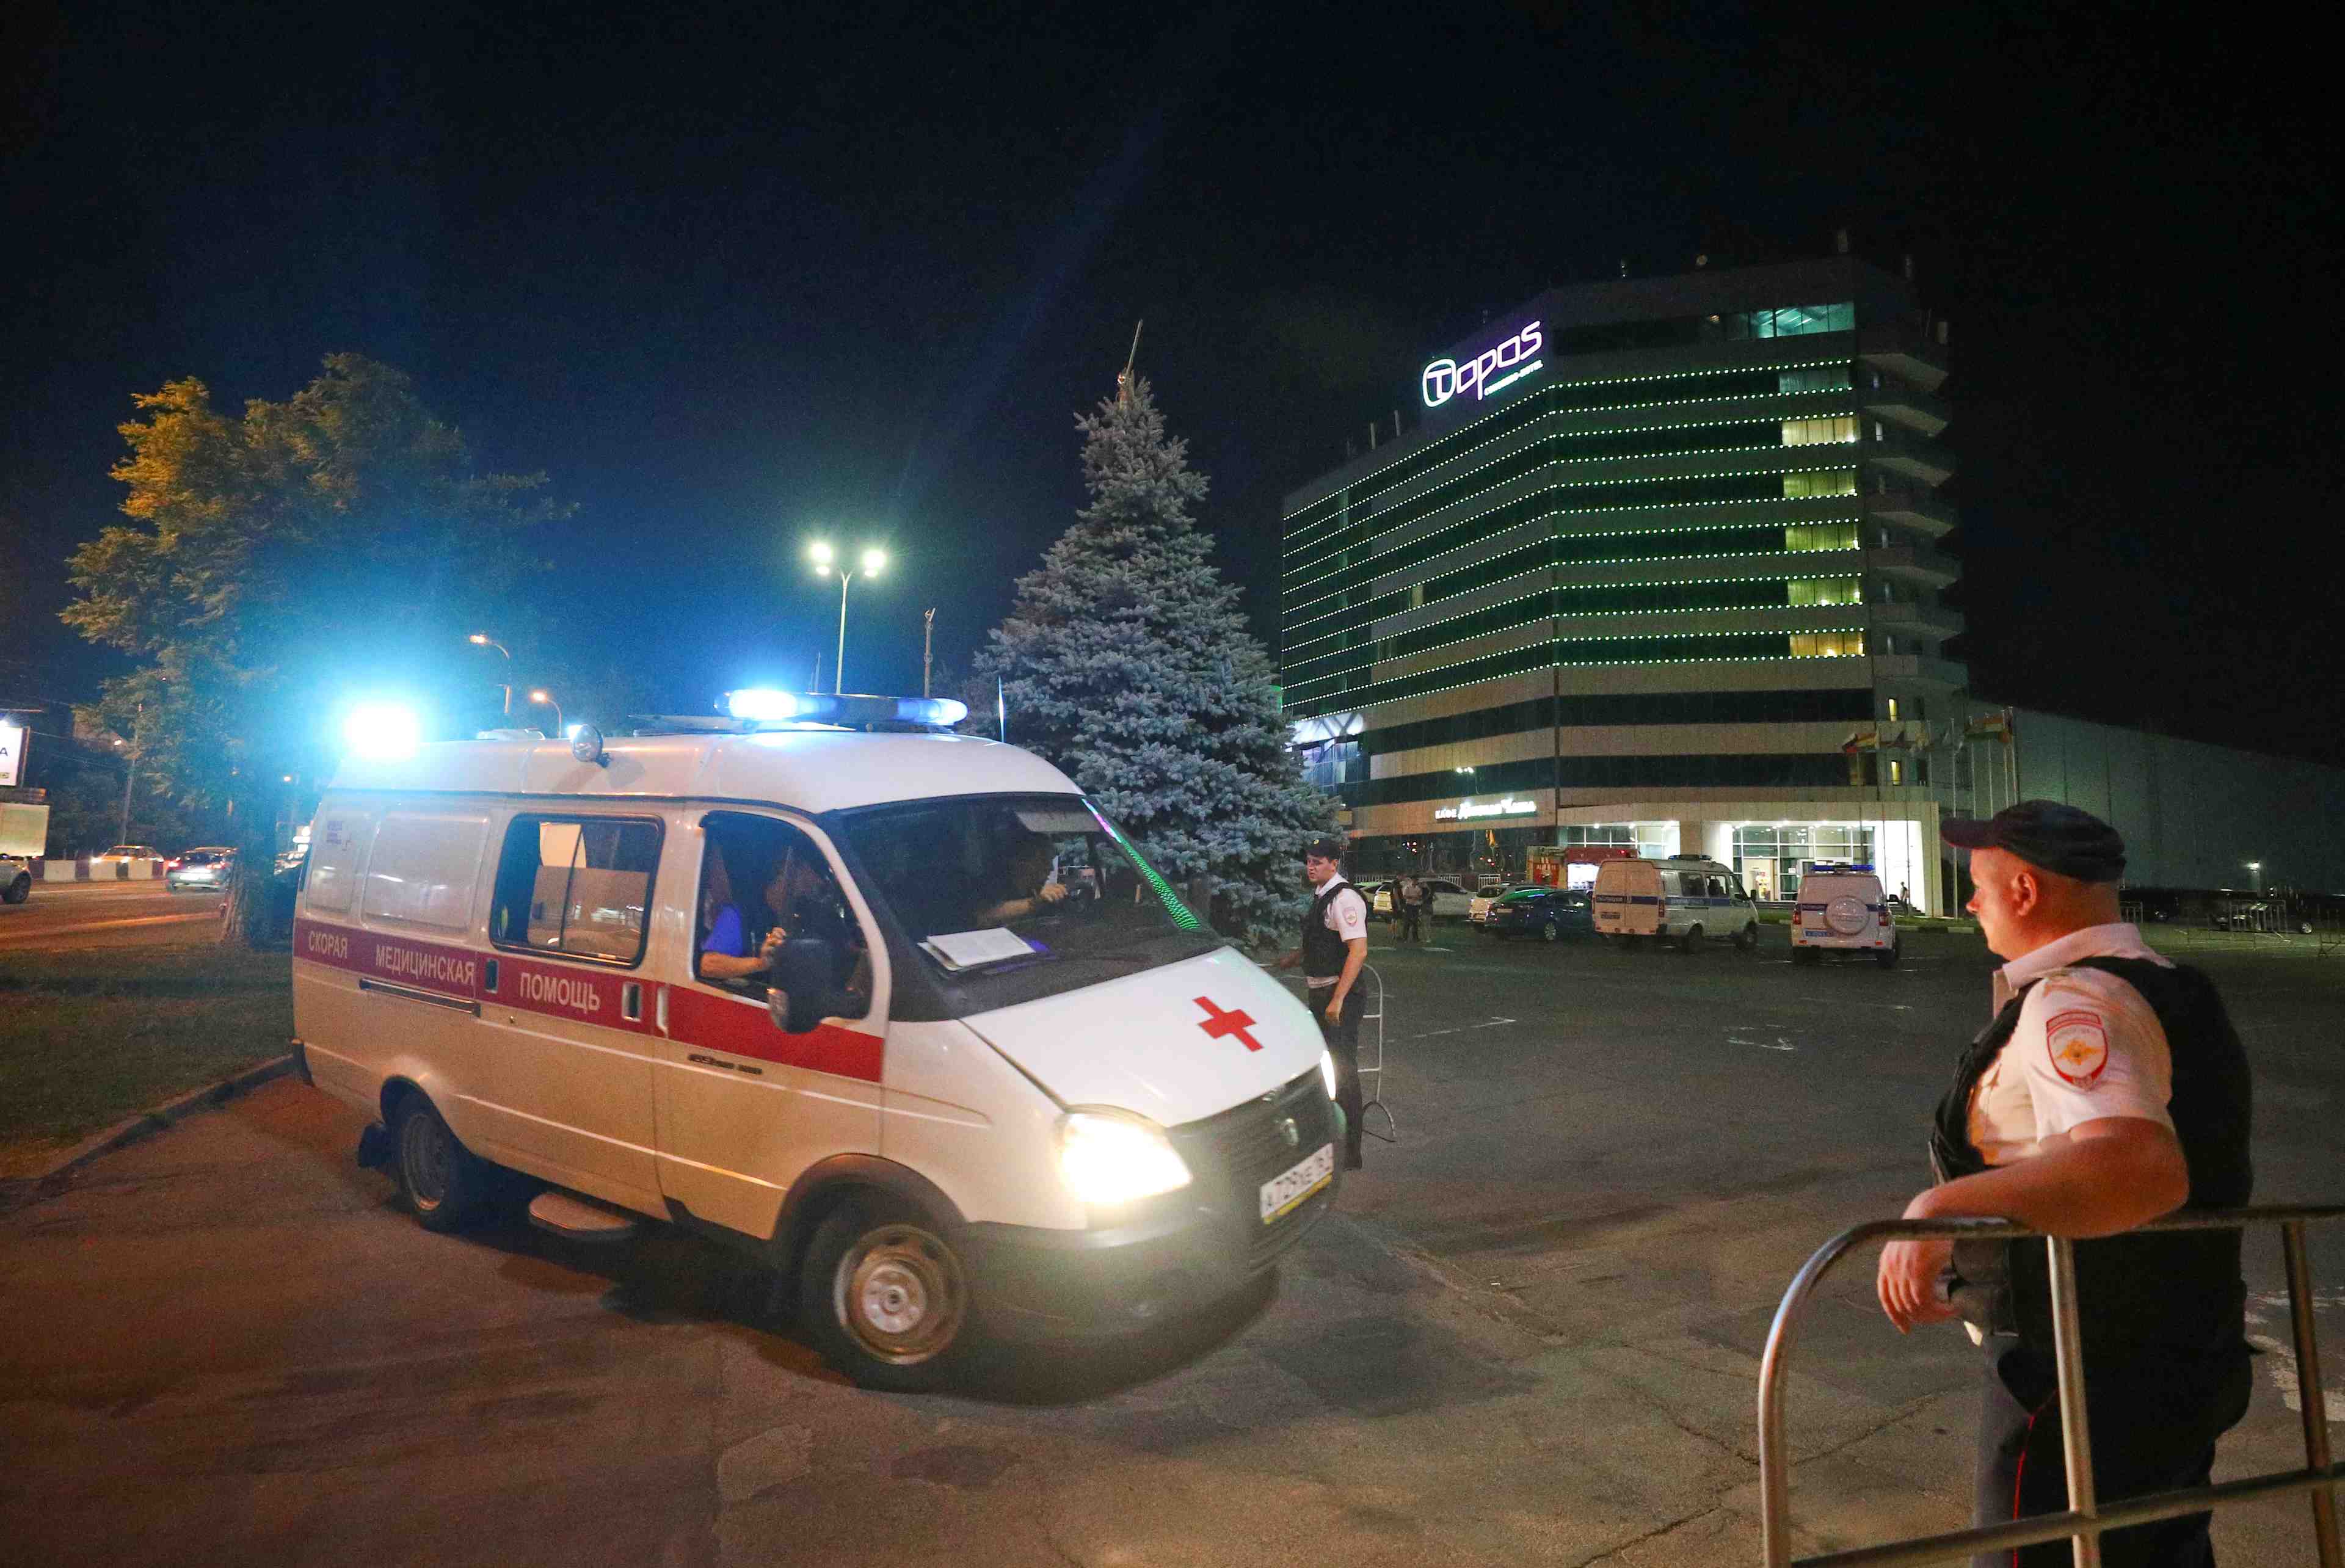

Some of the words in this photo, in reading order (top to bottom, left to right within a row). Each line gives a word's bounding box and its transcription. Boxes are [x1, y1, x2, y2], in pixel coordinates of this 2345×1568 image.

[308, 930, 347, 959] СКОРАЯ
[376, 944, 475, 986] МЕДИЦИНСКАЯ
[520, 971, 600, 1014] ПОМОЩЬ
